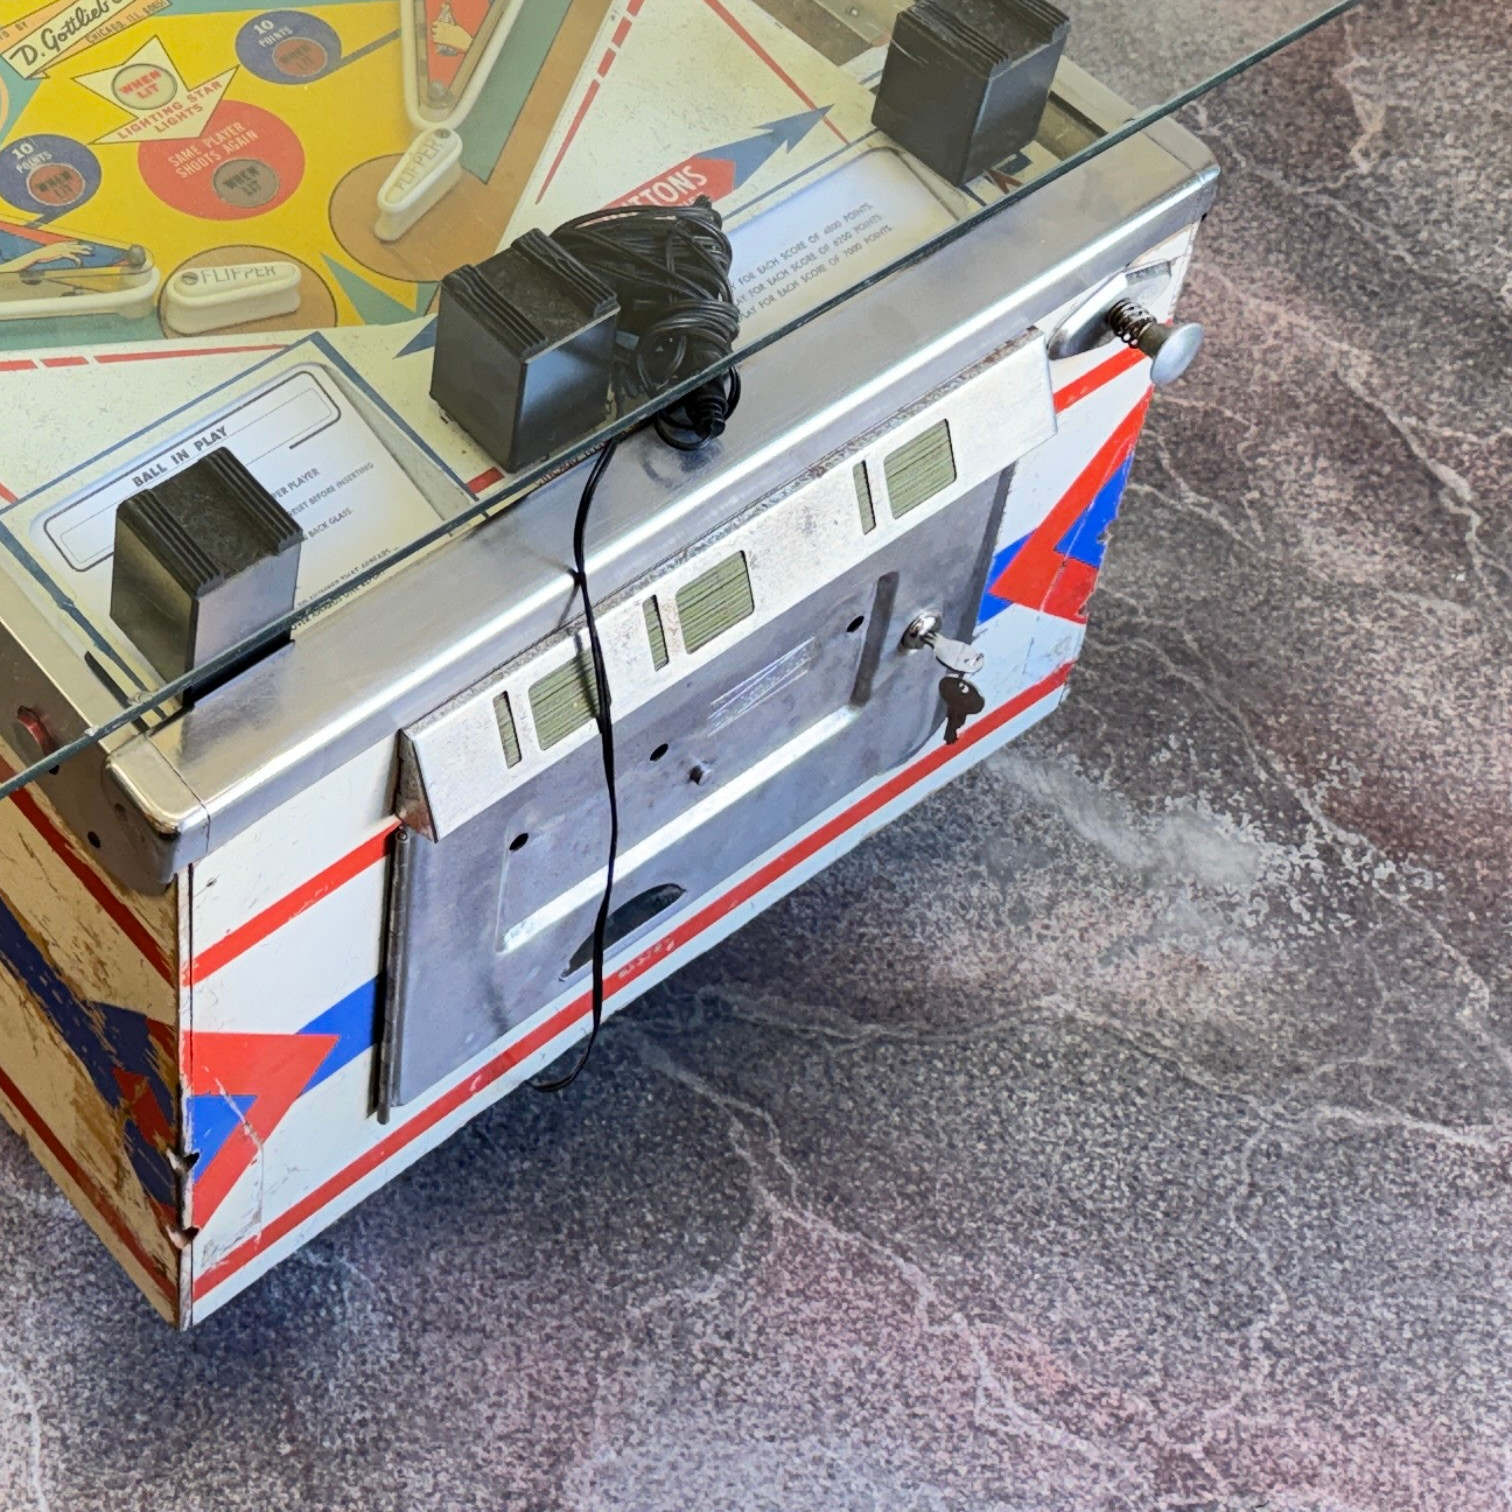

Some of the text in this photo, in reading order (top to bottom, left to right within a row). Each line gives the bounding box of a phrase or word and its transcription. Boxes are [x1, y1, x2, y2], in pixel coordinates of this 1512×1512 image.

[253, 19, 275, 36] 10
[258, 26, 294, 48] POINTS
[8, 43, 46, 67] D.
[119, 69, 162, 95] WHEN
[136, 83, 160, 100] LIT
[116, 80, 223, 140] LIGHTING STAR
[154, 103, 205, 134] LIGHTS
[11, 142, 34, 160] 10
[167, 121, 247, 168] SAME PLAYER
[175, 129, 260, 179] SHOOTS AGAIN
[16, 150, 53, 174] POINTS
[392, 138, 445, 192] FLIPPER
[222, 164, 261, 190] WHEN
[240, 180, 262, 197] LIT
[738, 271, 757, 286] FOR
[756, 257, 780, 276] EACH
[780, 241, 808, 261] SCORE
[808, 232, 821, 244] OF
[747, 282, 766, 299] FOR
[767, 268, 791, 286] EACH
[790, 252, 818, 273] SCORE
[818, 243, 831, 255] OF
[199, 265, 278, 285] FLIPPER
[758, 294, 778, 309] FOR
[776, 279, 801, 298] EACH
[800, 262, 829, 284] SCORE
[827, 254, 842, 267] OF
[131, 424, 228, 488] BALL IN PLAY
[287, 466, 321, 491] PLAYER
[309, 485, 337, 506] BEFORE
[335, 461, 376, 489] INSERTING
[308, 521, 331, 539] BACK
